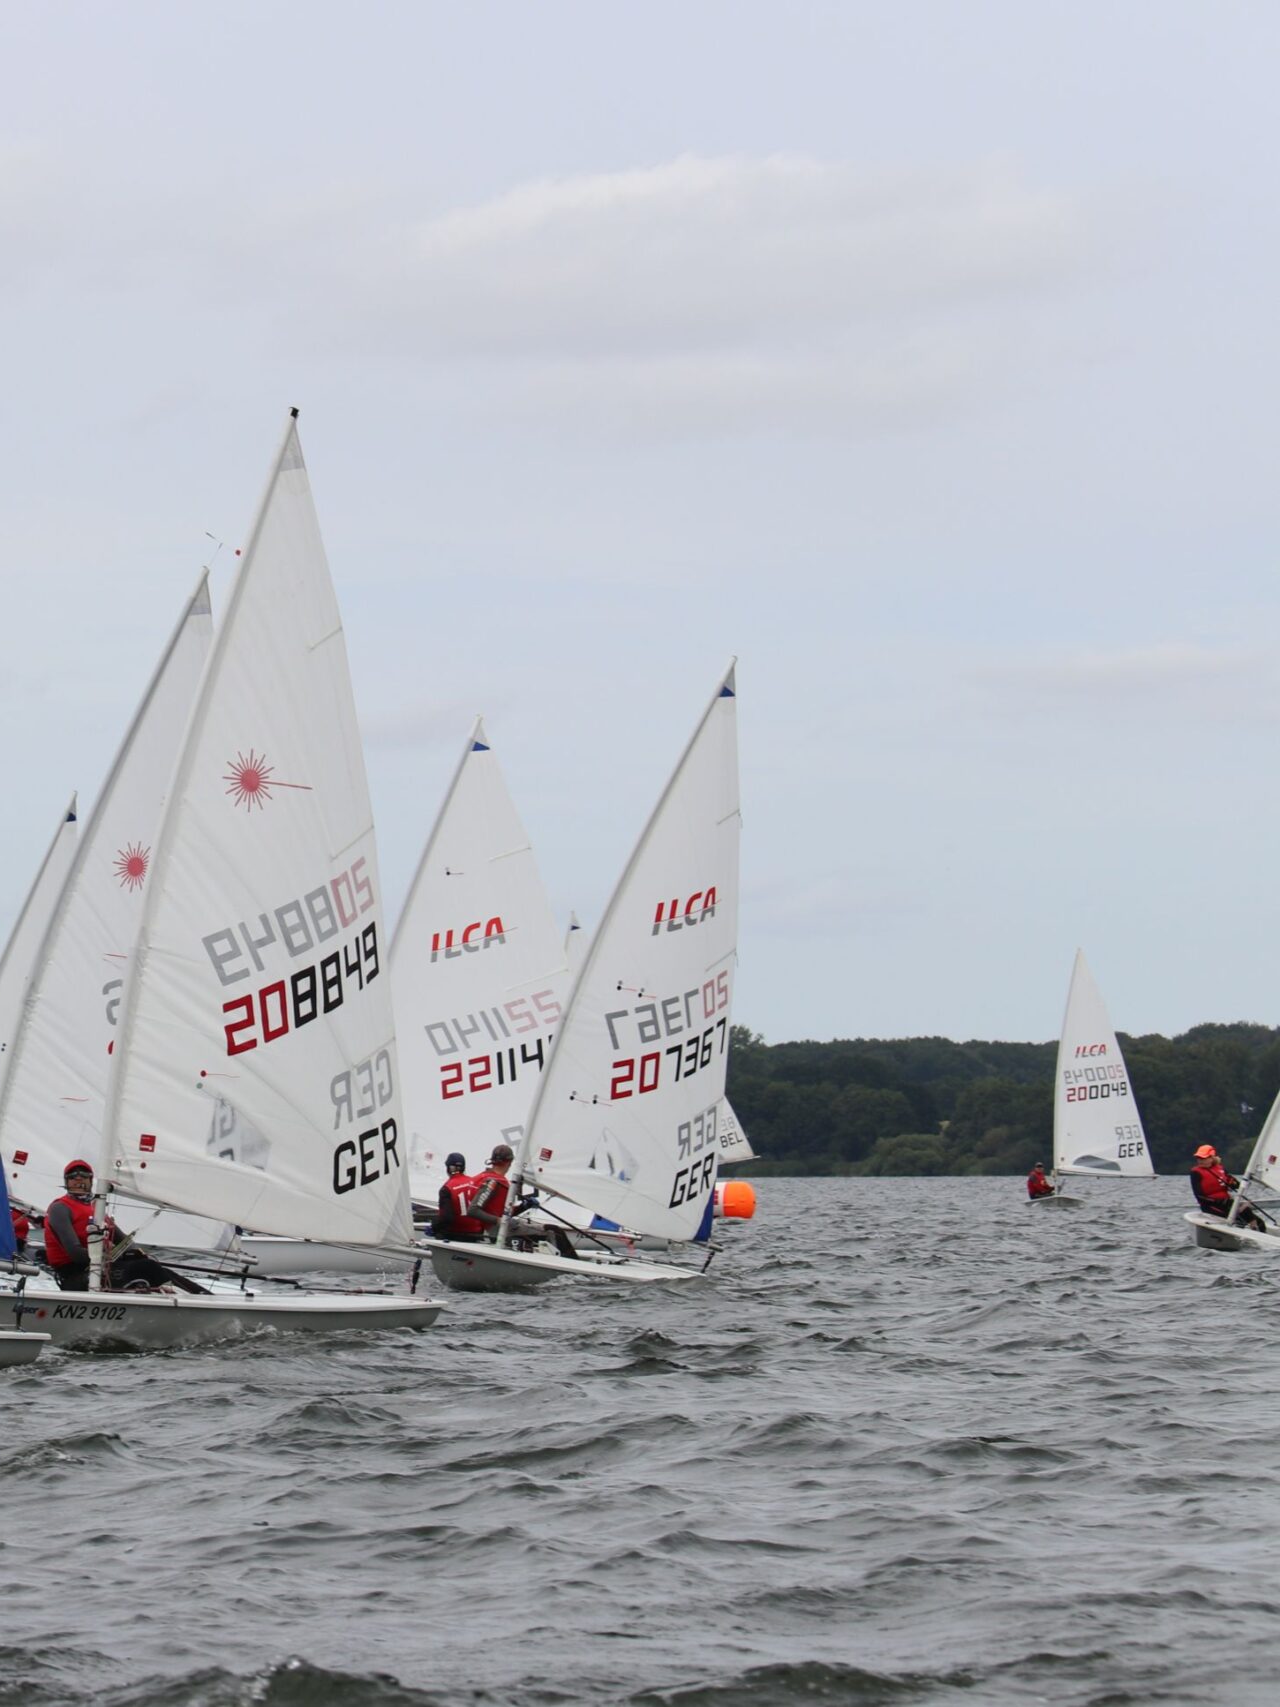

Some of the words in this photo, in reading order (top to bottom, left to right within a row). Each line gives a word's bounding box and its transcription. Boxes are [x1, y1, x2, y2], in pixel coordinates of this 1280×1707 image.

[651, 886, 717, 936] ILCA
[430, 916, 507, 963] ILCA
[223, 921, 380, 1056] 208849
[440, 1034, 553, 1100] 22114
[611, 1017, 727, 1100] 207367
[1075, 1044, 1107, 1058] ILCA
[1067, 1082, 1128, 1102] 200049
[333, 1118, 400, 1194] GER
[720, 1131, 743, 1148] BEL
[1118, 1142, 1144, 1158] GER
[669, 1152, 715, 1208] GER
[52, 1305, 87, 1319] KN2
[89, 1305, 127, 1321] 9102
